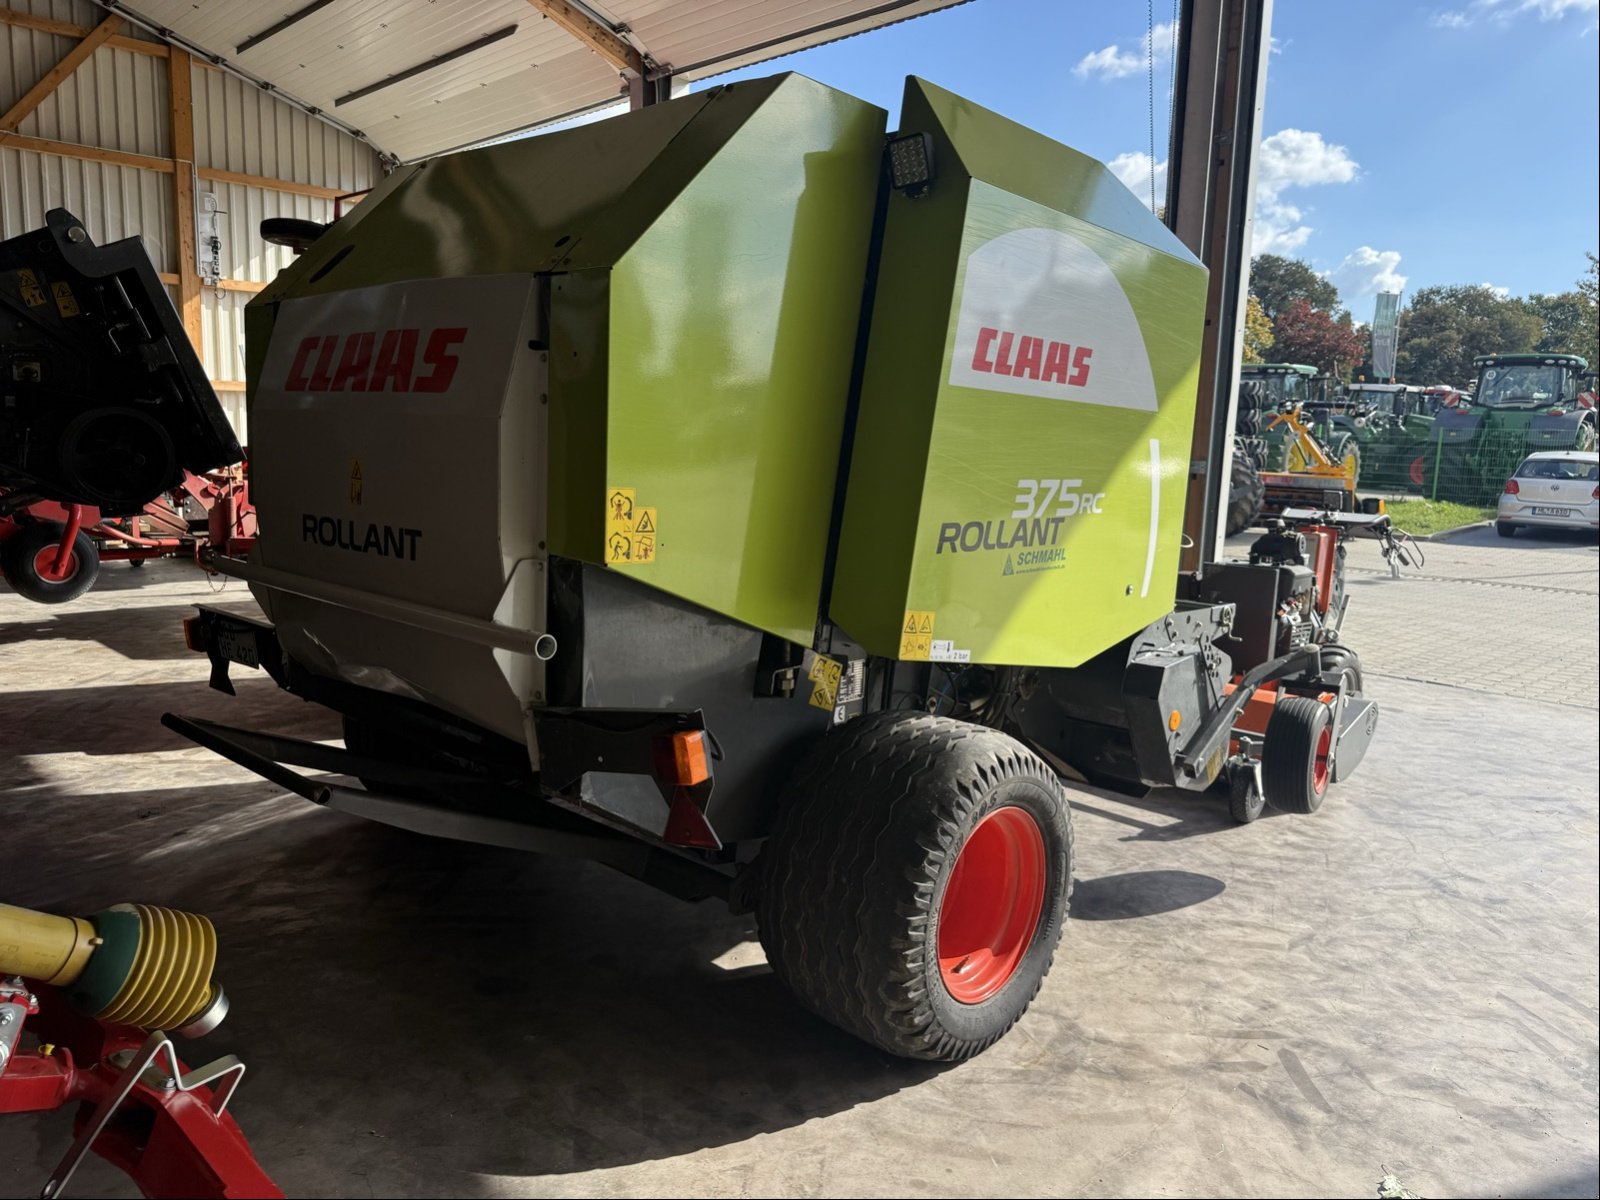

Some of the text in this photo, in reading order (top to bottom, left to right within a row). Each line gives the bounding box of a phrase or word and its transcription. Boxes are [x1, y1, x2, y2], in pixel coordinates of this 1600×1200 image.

[284, 327, 468, 393] CLAAS
[972, 327, 1093, 387] CLAAS
[302, 513, 422, 561] ROLLANT
[936, 517, 1065, 554] ROLLANT
[1017, 548, 1066, 566] SCHMAHL
